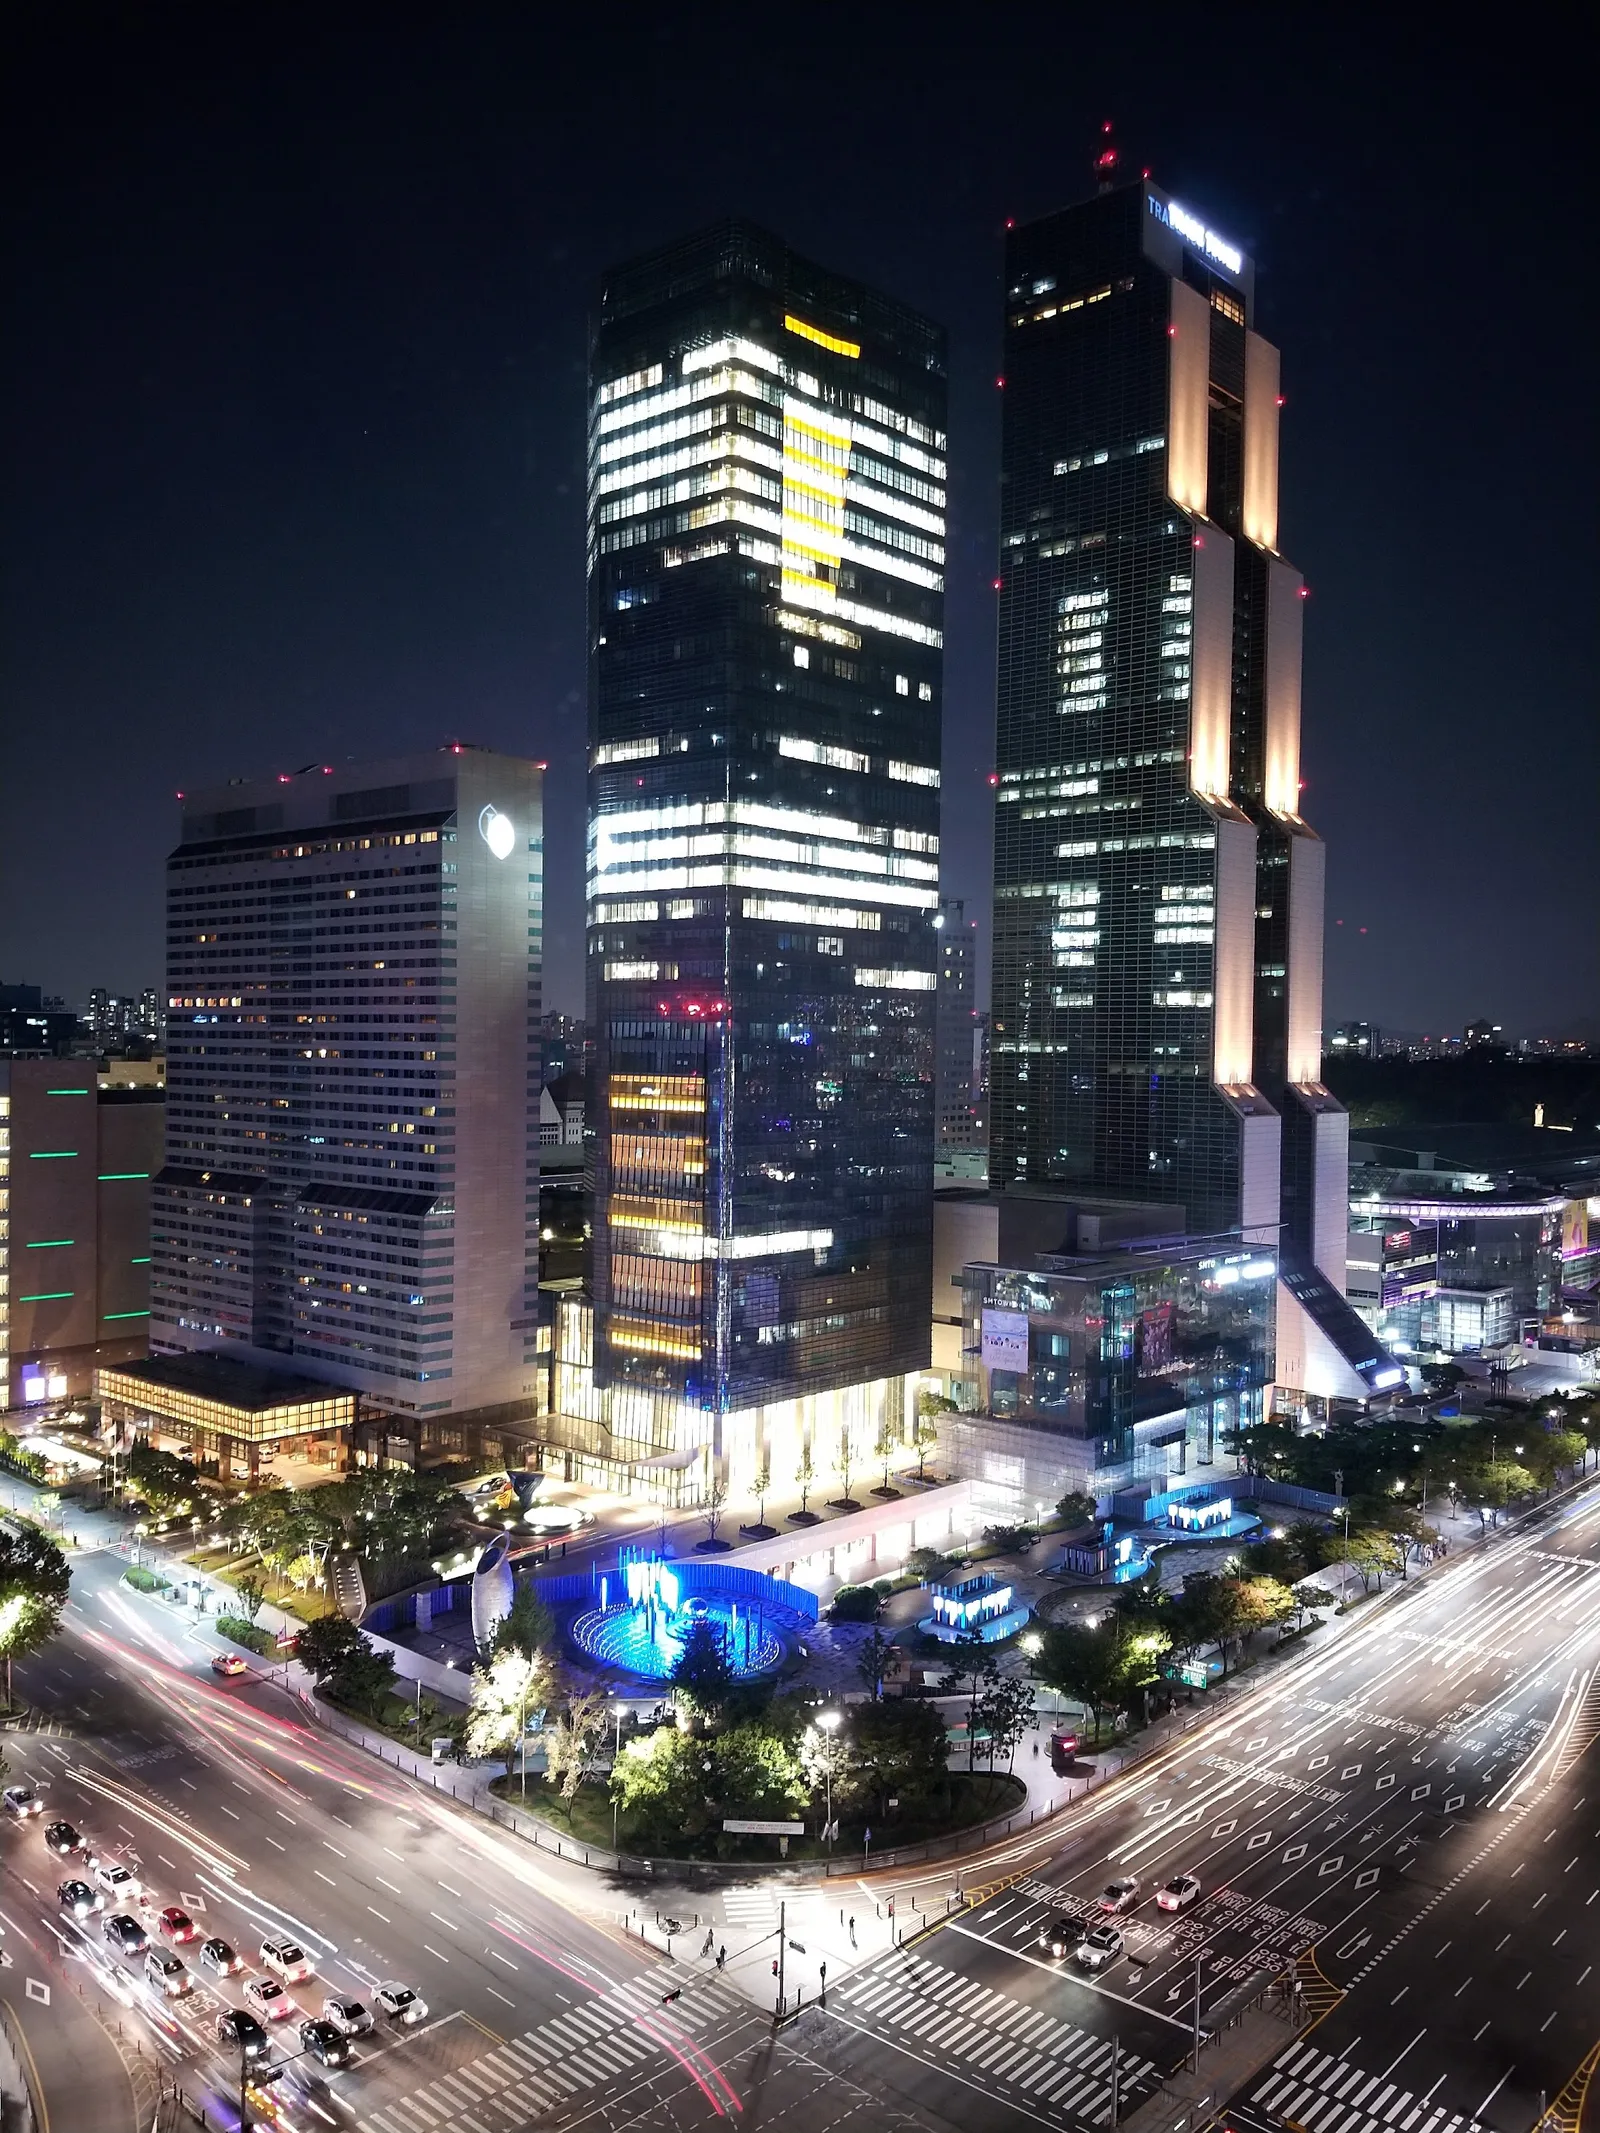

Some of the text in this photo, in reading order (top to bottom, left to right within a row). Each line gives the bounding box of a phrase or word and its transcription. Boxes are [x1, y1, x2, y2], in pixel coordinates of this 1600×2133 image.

[1213, 1889, 1252, 1911] 경찰서
[1194, 1903, 1234, 1925] 강남
[1250, 1903, 1289, 1926] 경찰서
[1172, 1919, 1214, 1941] 운동장
[1231, 1916, 1272, 1940] 강남
[1287, 1916, 1328, 1940] 경찰서
[1269, 1931, 1310, 1955] 강남
[173, 1990, 220, 2020] 운동장
